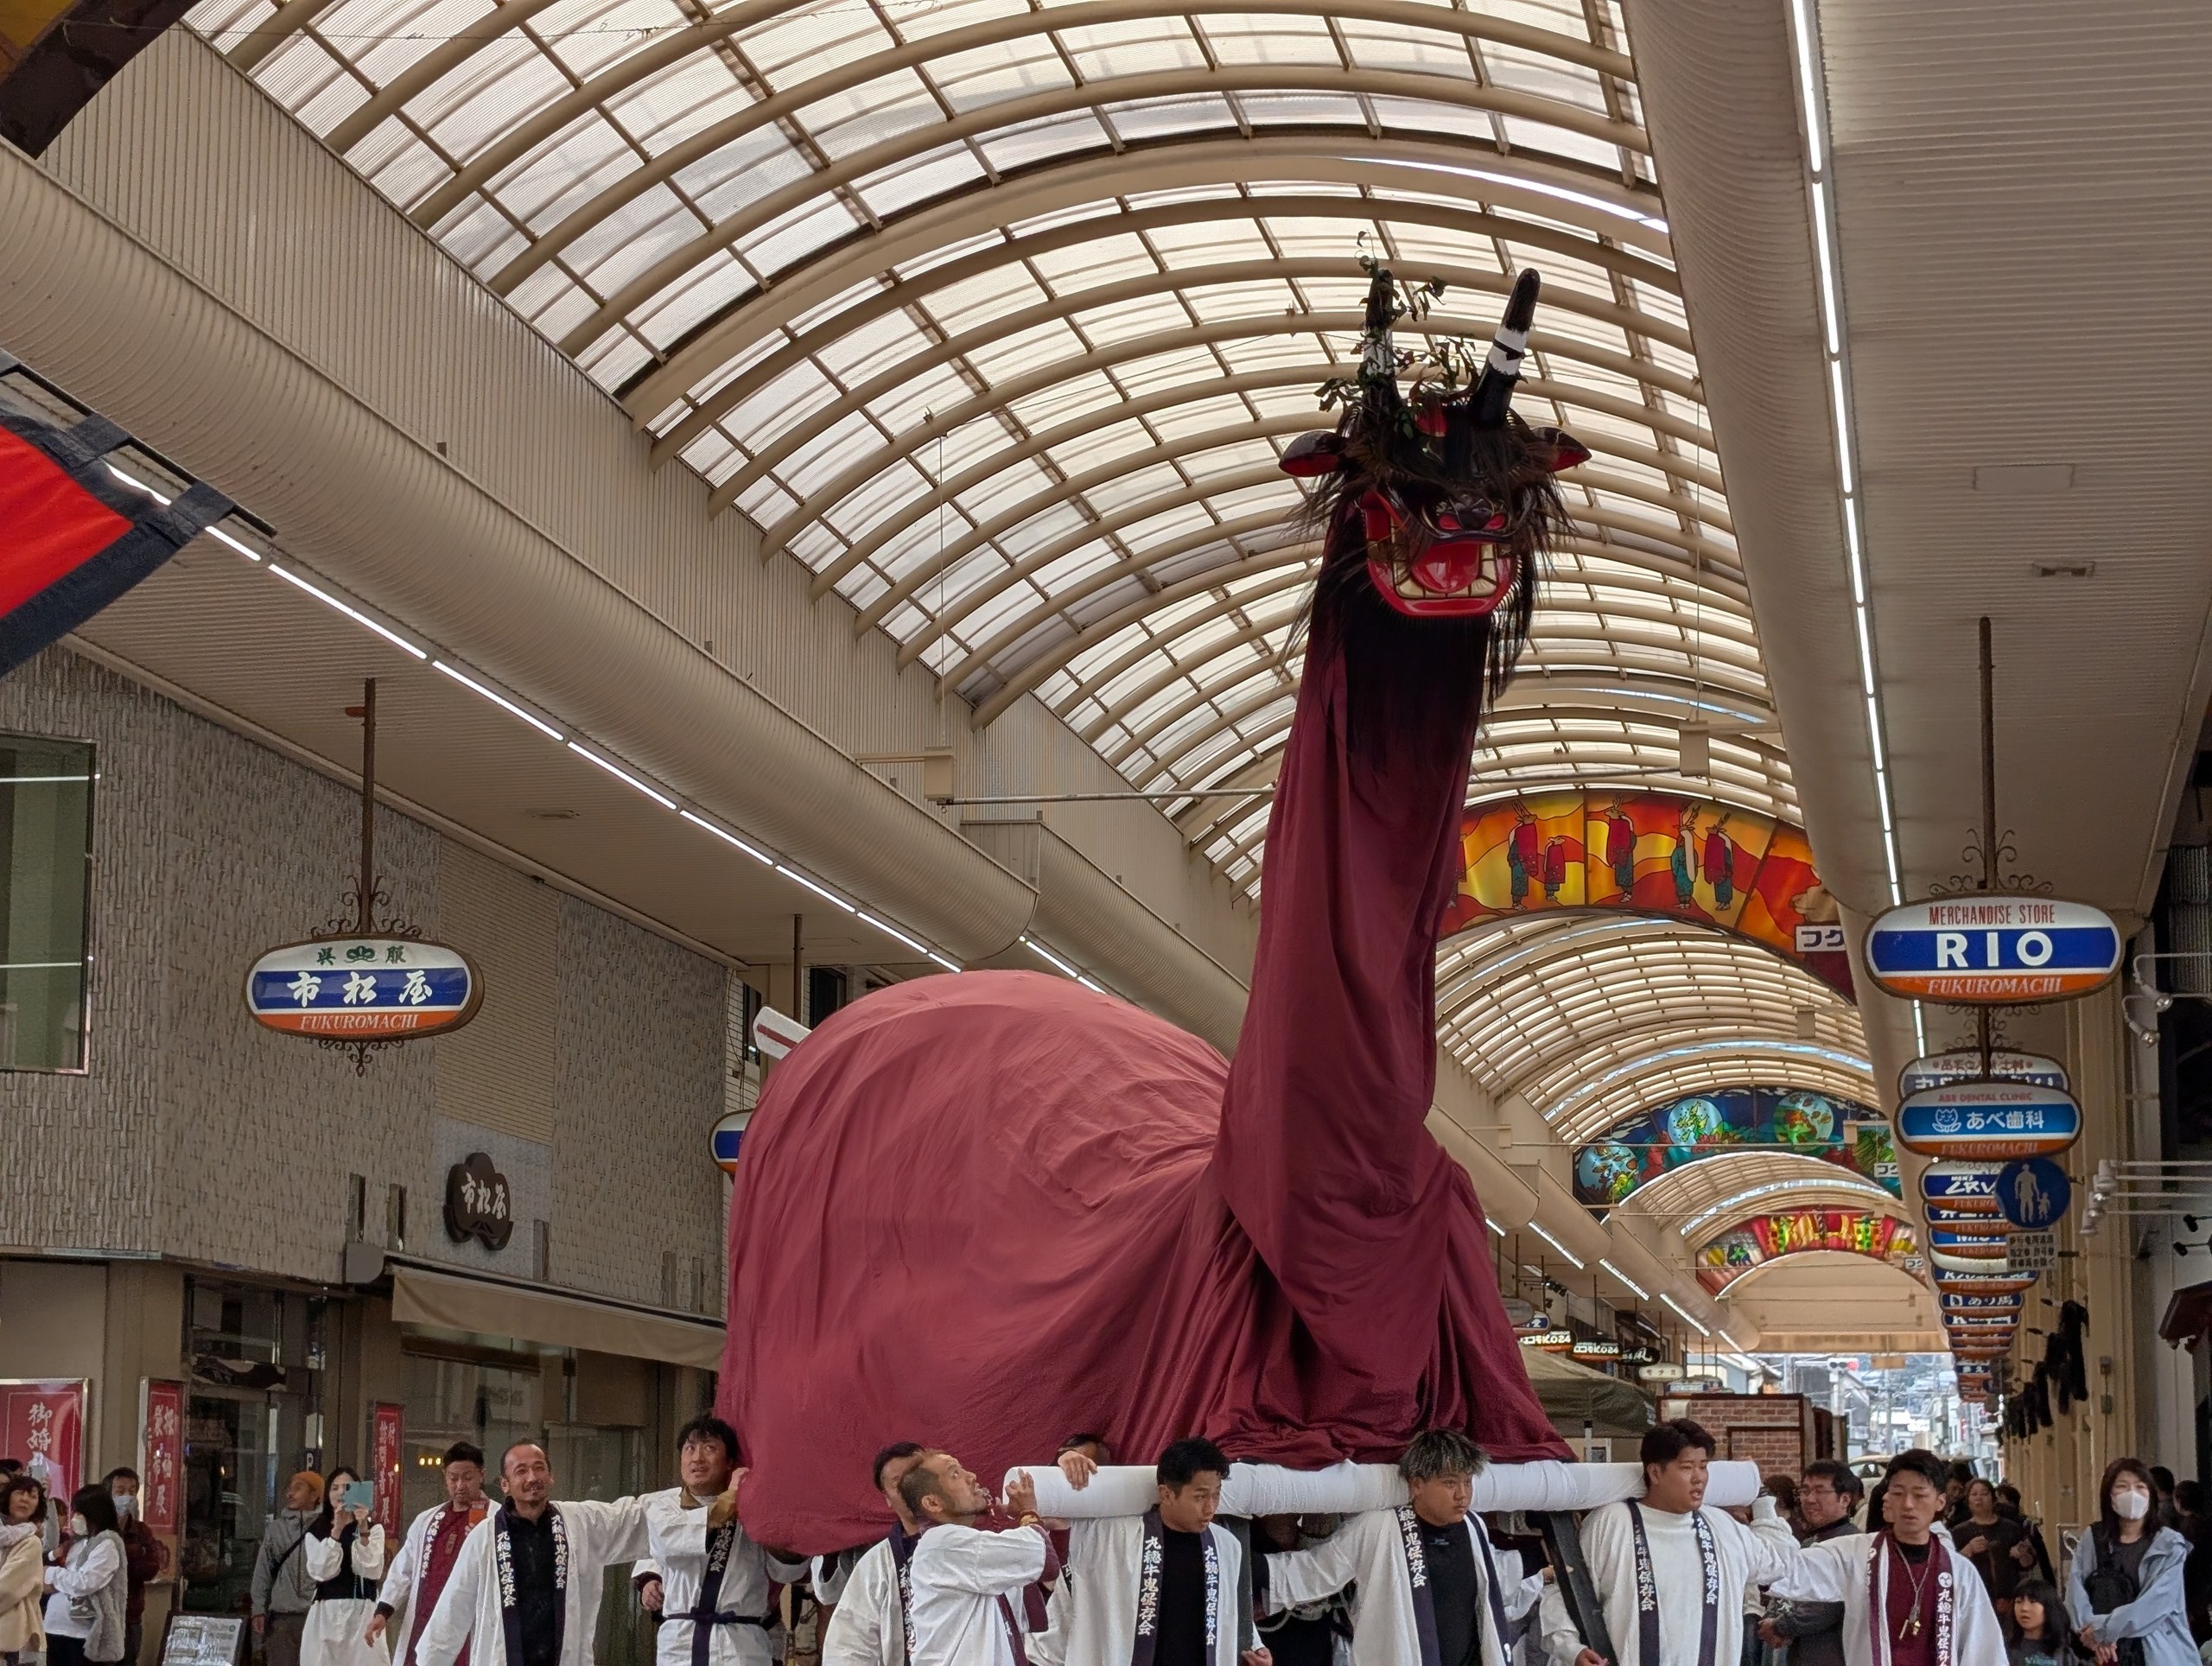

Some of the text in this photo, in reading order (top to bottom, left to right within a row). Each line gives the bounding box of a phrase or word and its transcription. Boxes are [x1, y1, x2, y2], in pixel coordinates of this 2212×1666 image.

[1929, 904, 2056, 925] MERCHANDISE STORE
[1936, 931, 2053, 969] RIO
[287, 971, 432, 1008] 市松屋
[1927, 976, 2063, 995] FUKUROMACHI
[300, 1014, 418, 1030] FUKUROMACHI
[1960, 1092, 1996, 1103] DENTAL
[1999, 1091, 2033, 1102] CLINIC
[1966, 1110, 2044, 1130] あべ歯科
[27, 1401, 53, 1460] 御婚
